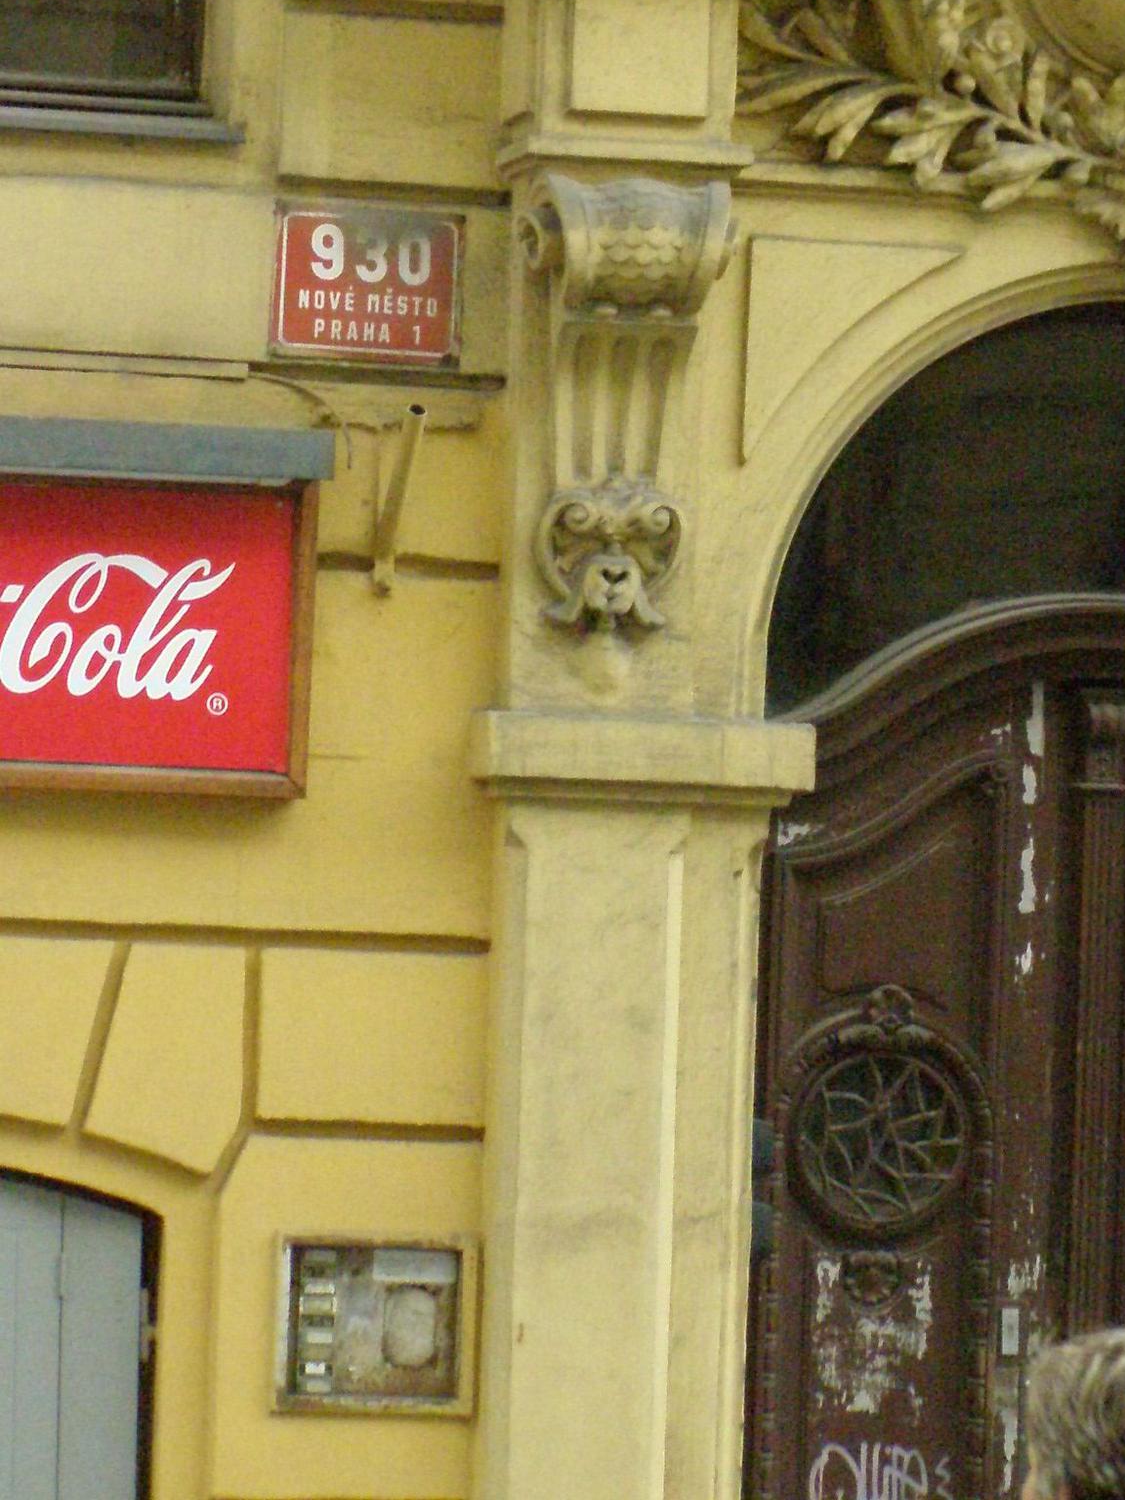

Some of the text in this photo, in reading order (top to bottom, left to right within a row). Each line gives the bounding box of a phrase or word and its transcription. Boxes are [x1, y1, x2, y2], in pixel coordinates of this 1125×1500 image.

[310, 223, 432, 286] 930
[298, 286, 438, 318] NOVÉ MĚSTO
[313, 318, 421, 346] PRAHA 1
